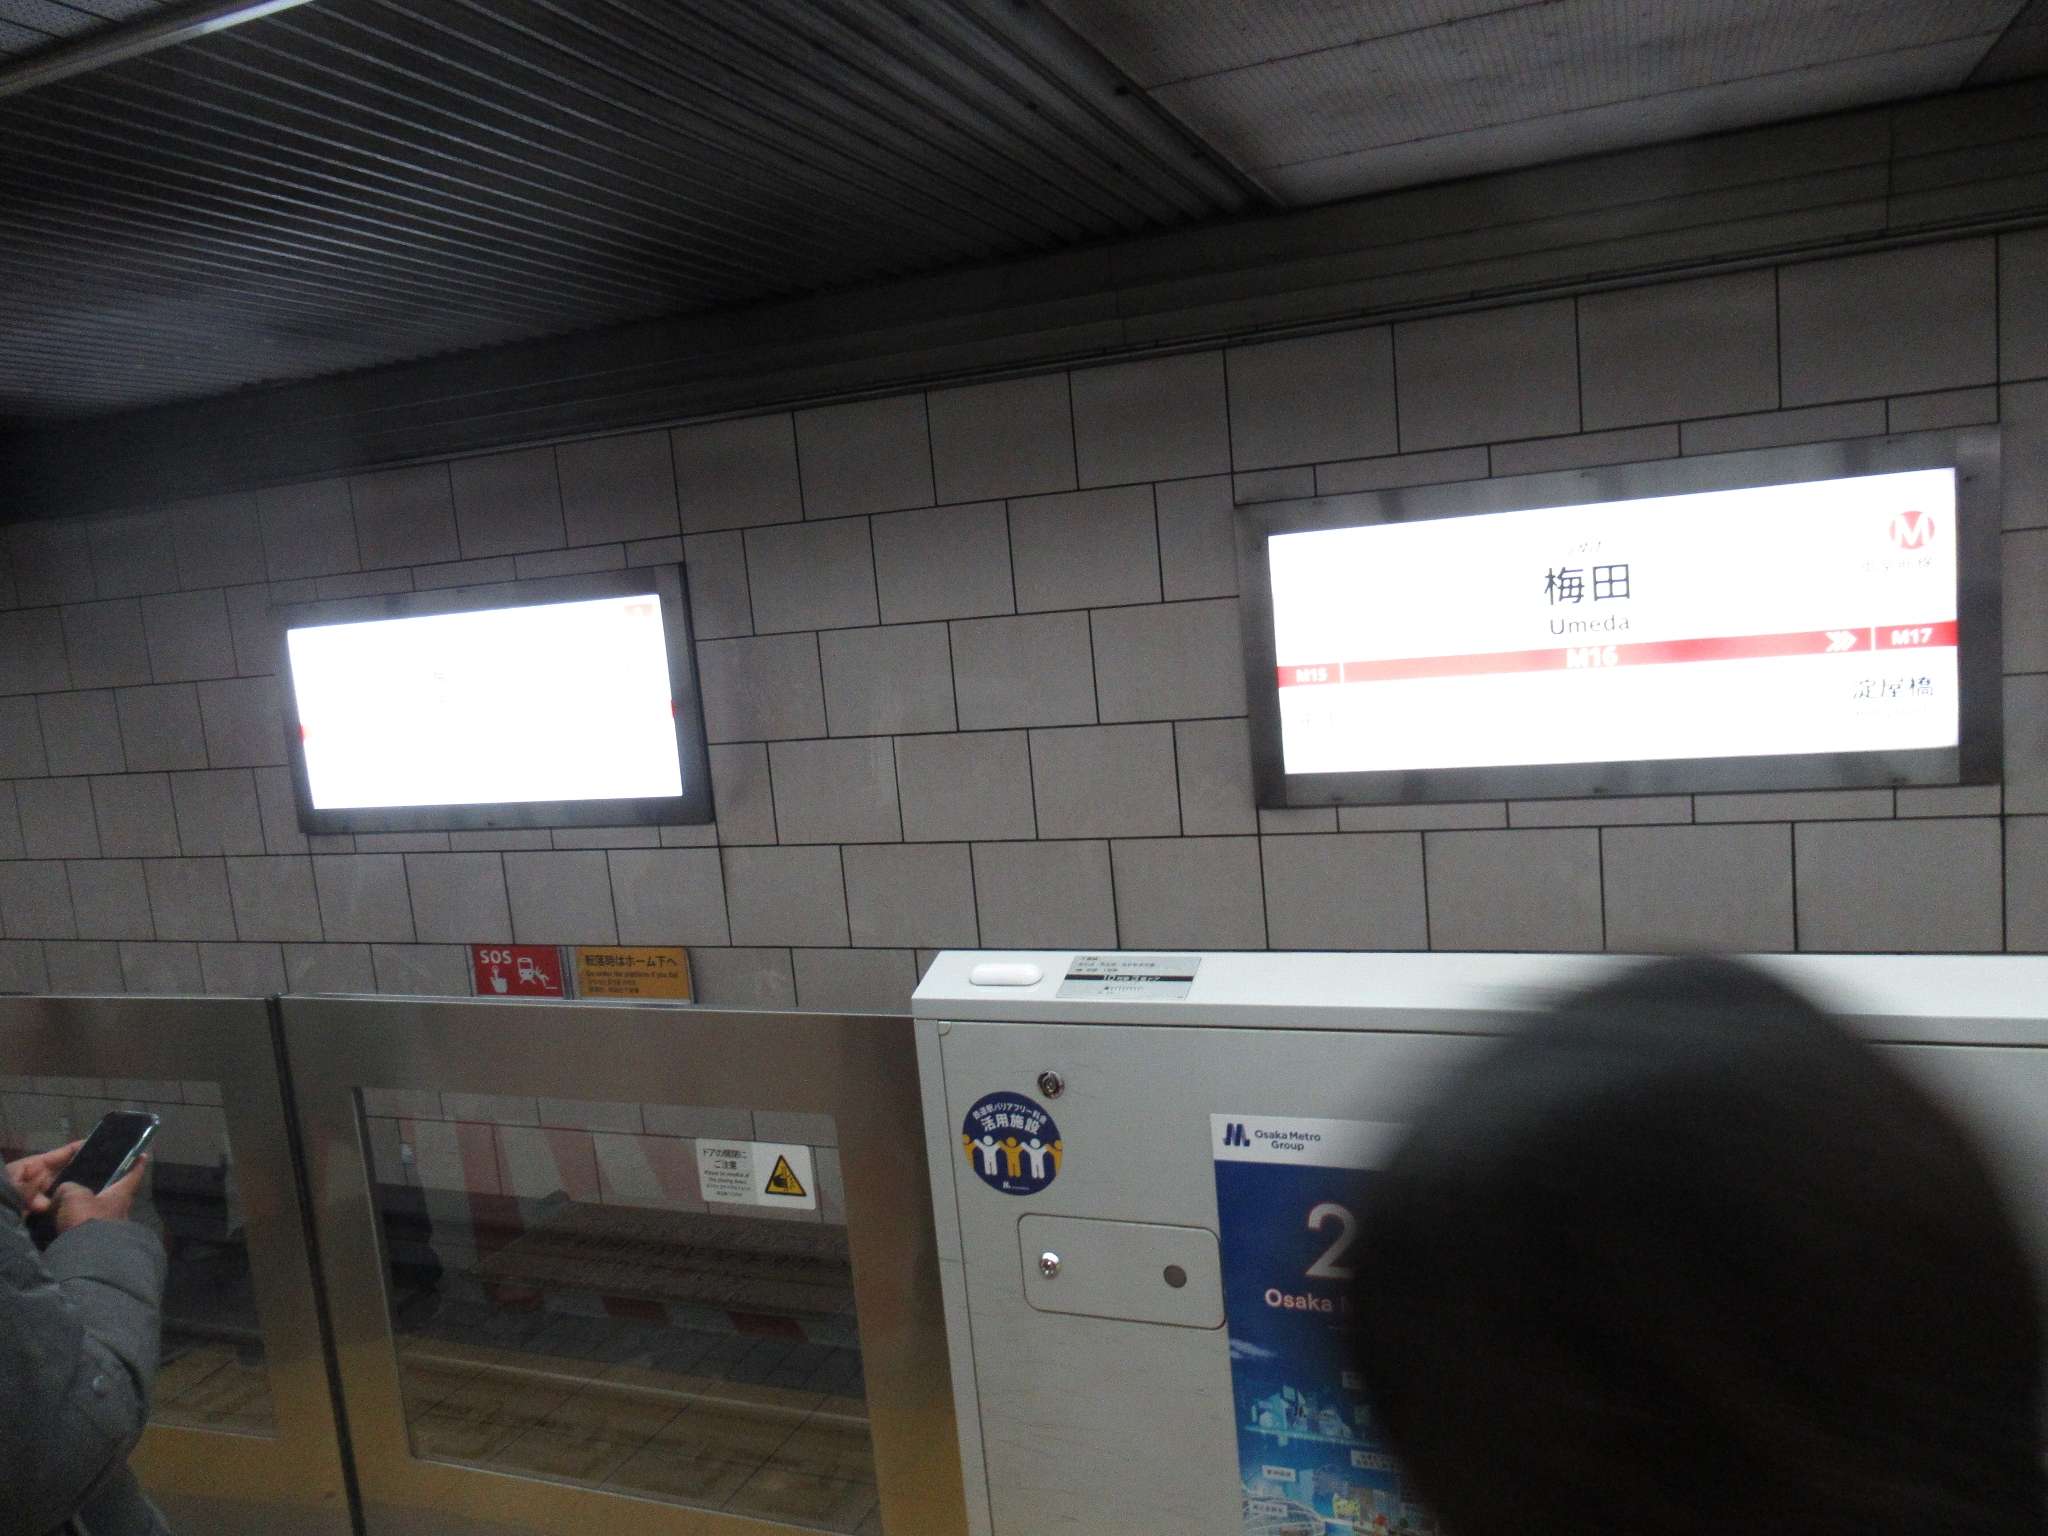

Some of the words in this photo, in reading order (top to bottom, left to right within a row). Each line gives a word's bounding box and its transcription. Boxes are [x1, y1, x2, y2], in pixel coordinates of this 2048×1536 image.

[1543, 563, 1631, 606] 梅田
[1549, 614, 1630, 635] Umeda
[1891, 627, 1933, 646] M17
[1566, 645, 1619, 669] M16
[479, 949, 512, 965] SOS
[980, 1113, 1041, 1134] 活用施設
[1254, 1128, 1288, 1140] Osaka
[1289, 1130, 1321, 1141] Metro
[1271, 1140, 1305, 1151] Group
[1264, 1288, 1334, 1313] Osaka
